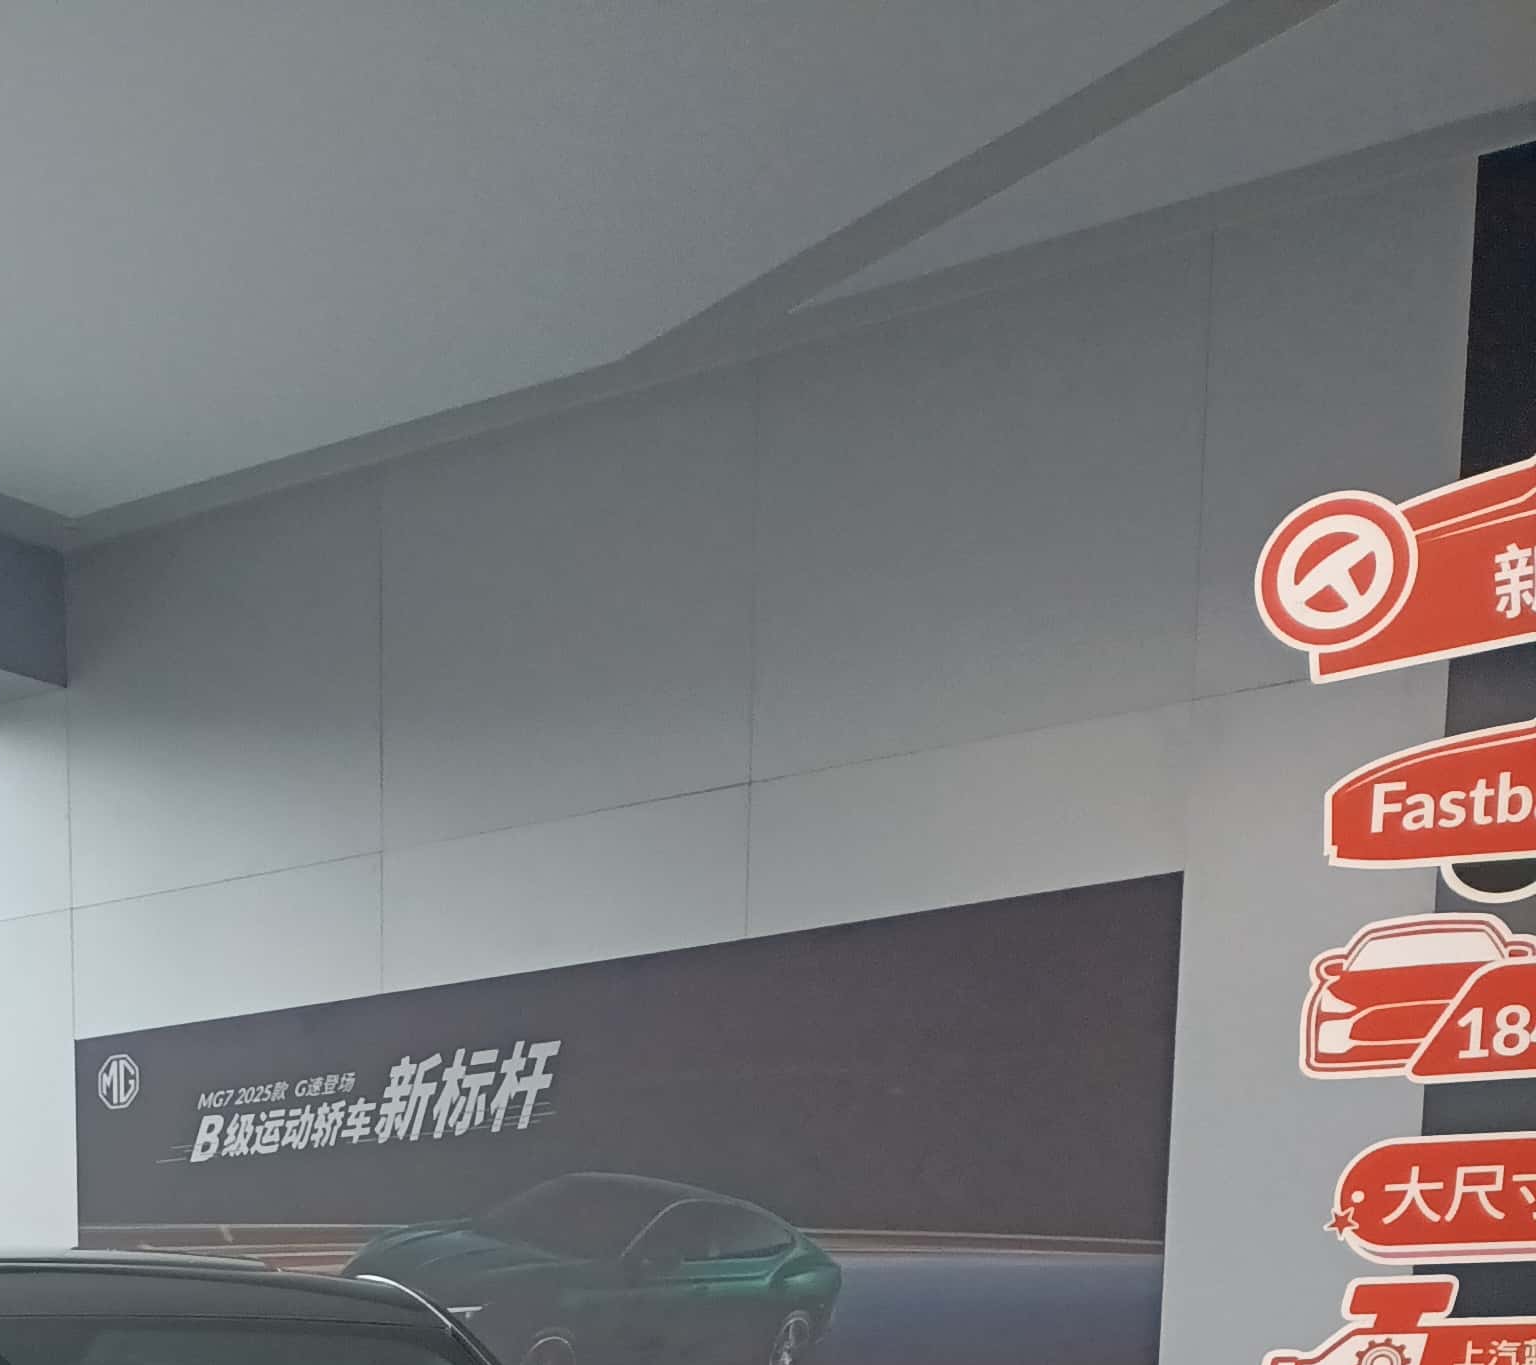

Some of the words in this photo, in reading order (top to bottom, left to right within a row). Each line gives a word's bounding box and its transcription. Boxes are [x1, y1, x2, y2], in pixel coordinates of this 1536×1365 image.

[1495, 543, 1536, 619] 新
[1370, 771, 1536, 834] Fastb
[1457, 1004, 1536, 1059] 18
[101, 1057, 136, 1106] MG
[197, 1086, 235, 1111] MG7
[234, 1080, 290, 1107] 2025款
[374, 1040, 562, 1144] 新标杆
